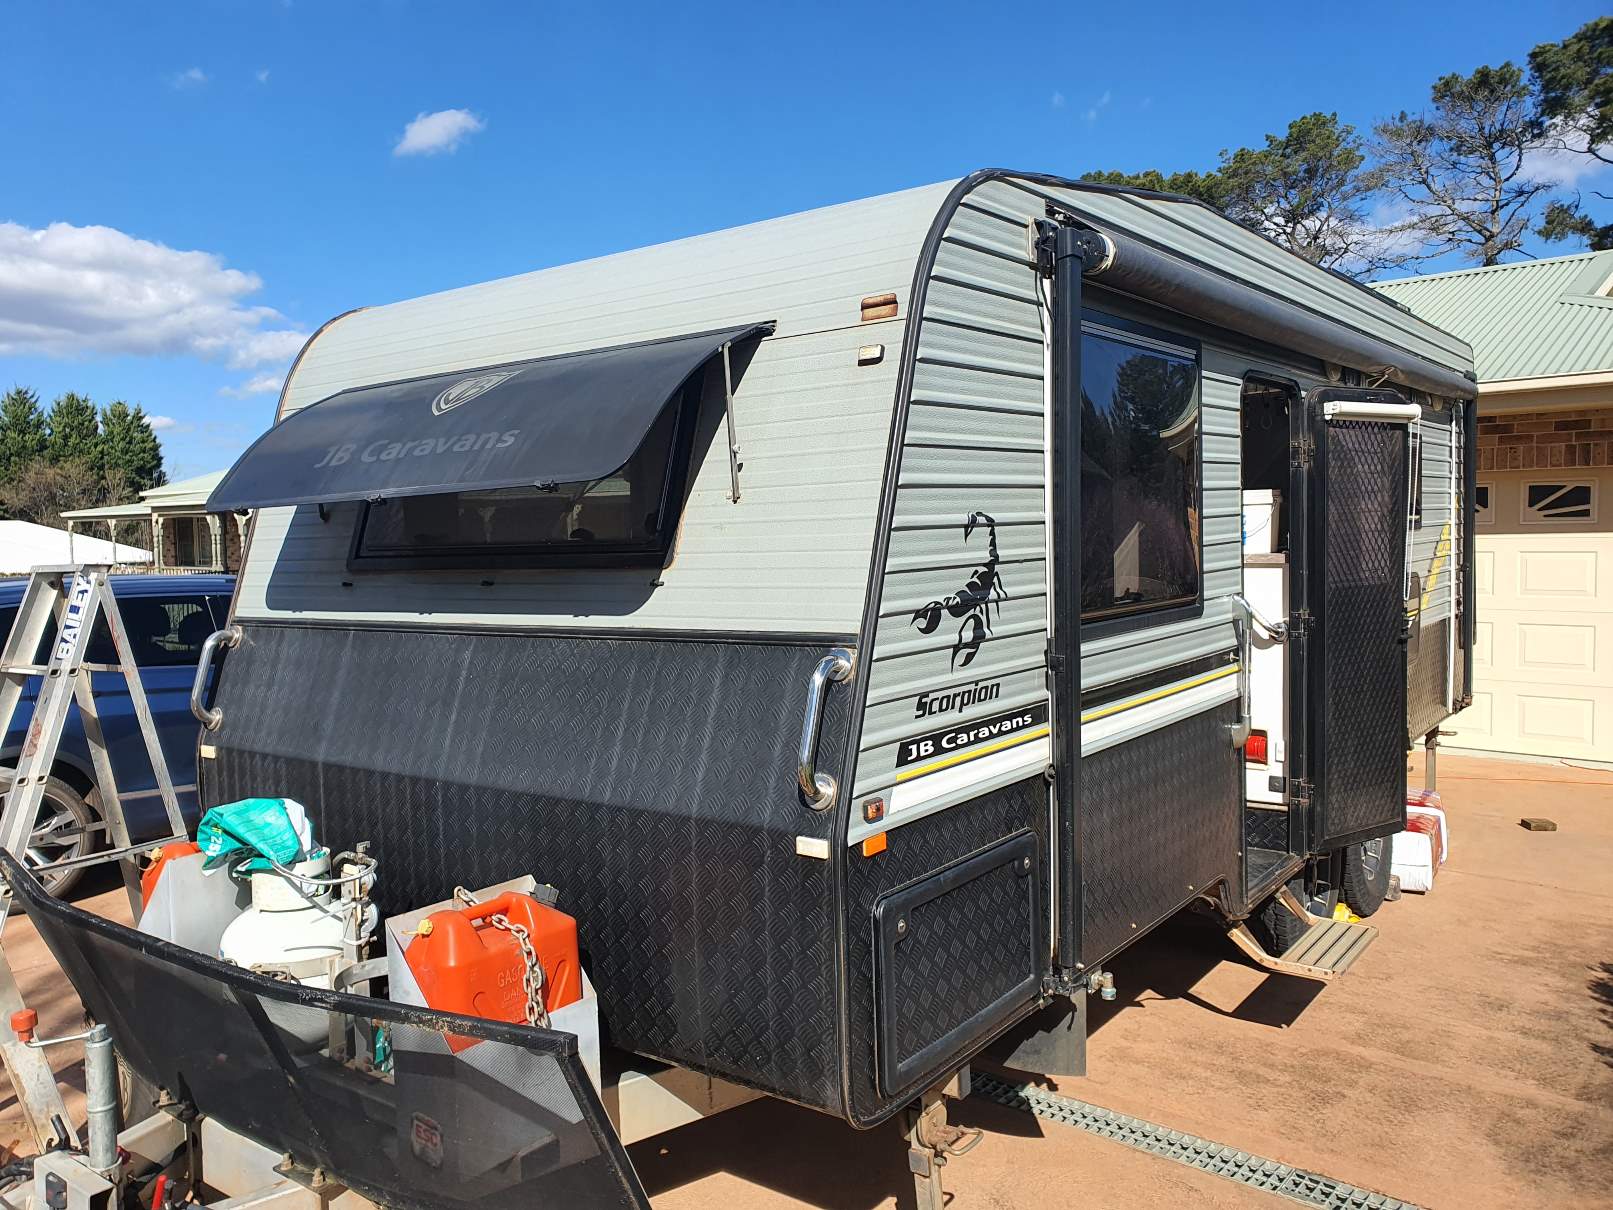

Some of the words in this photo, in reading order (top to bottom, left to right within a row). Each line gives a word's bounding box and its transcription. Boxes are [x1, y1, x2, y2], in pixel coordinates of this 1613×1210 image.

[314, 444, 357, 469] JB
[361, 429, 520, 463] Caravans
[56, 574, 92, 660] BAILEY
[915, 680, 1000, 719] Scorpion
[908, 740, 935, 760] JB
[941, 714, 1032, 748] Caravans
